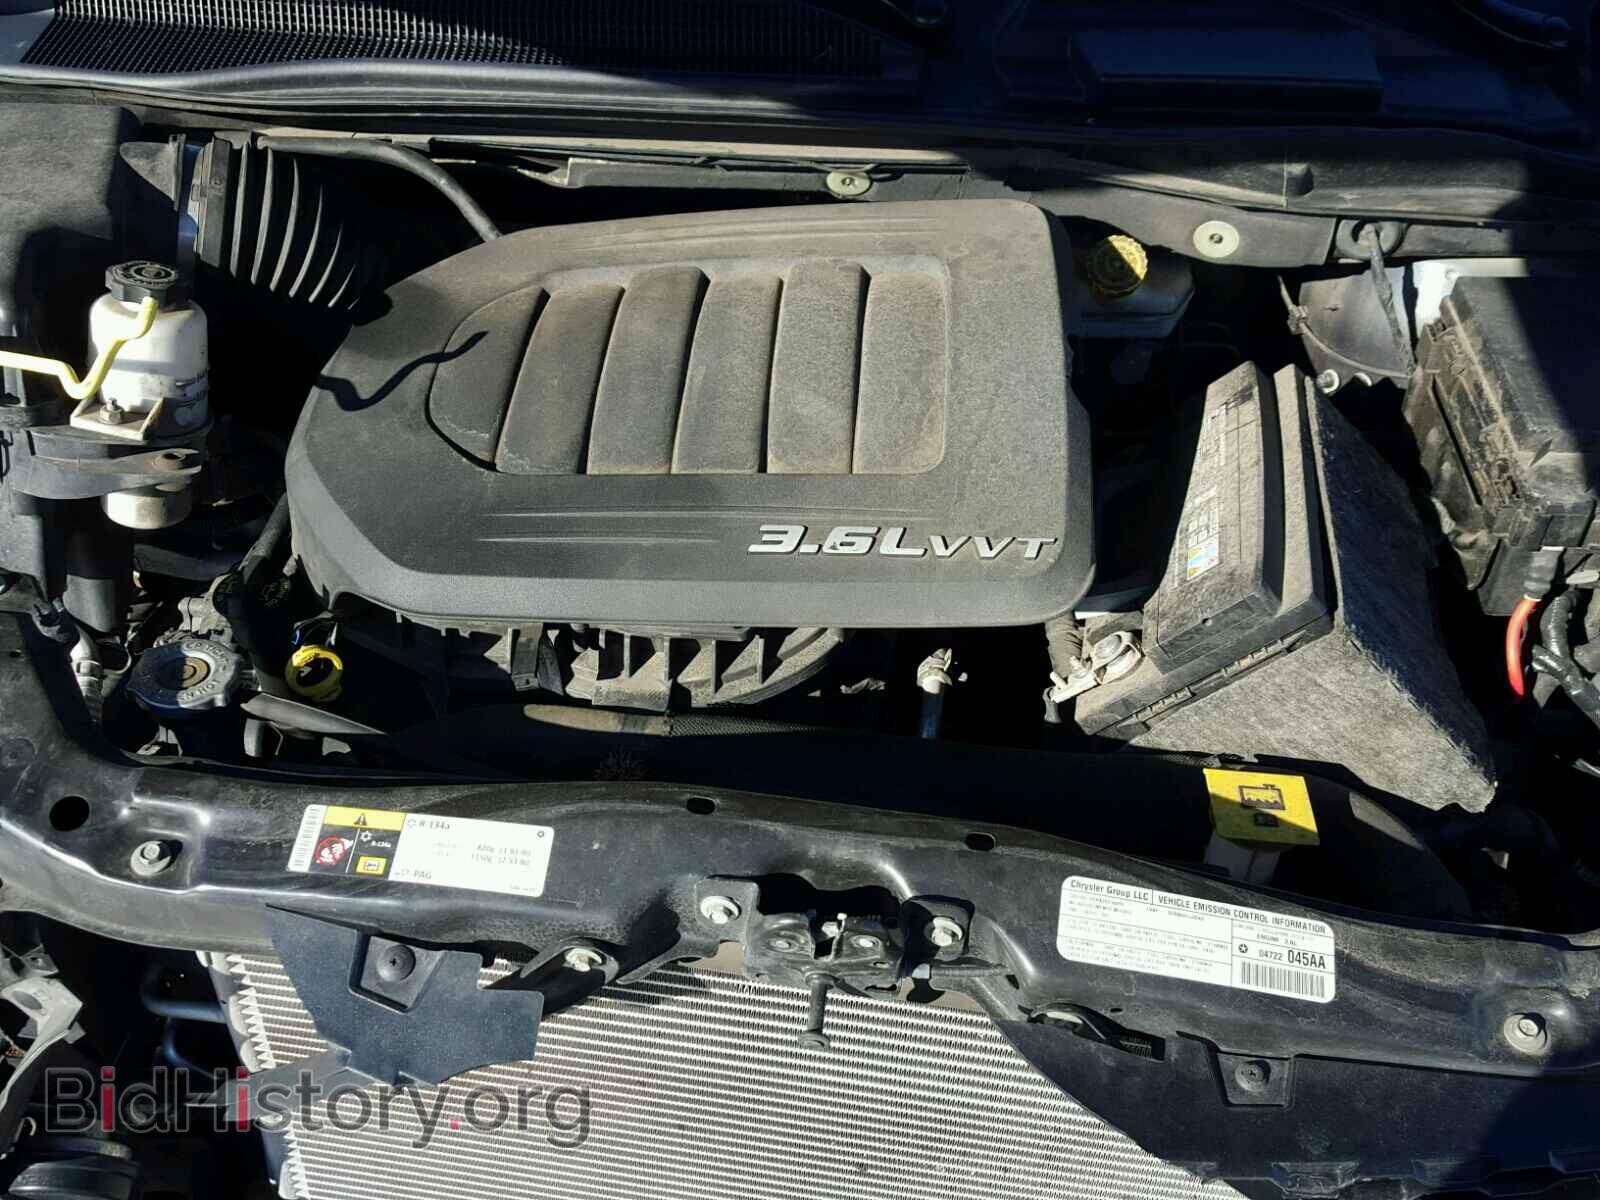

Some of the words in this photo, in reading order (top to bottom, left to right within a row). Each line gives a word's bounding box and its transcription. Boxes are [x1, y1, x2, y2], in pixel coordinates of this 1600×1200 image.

[748, 525, 927, 557] 3.6L
[929, 535, 1057, 560] VVT
[1070, 879, 1104, 894] Chrysler
[1106, 884, 1131, 899] Group
[1133, 889, 1149, 901] LLC
[1158, 895, 1191, 909] VEHICLE
[1193, 901, 1231, 916] EMISSION
[1233, 907, 1269, 924] CONTROL
[1272, 916, 1326, 934] INFORMATION
[1258, 949, 1283, 961] 04722
[1287, 949, 1326, 969] 045AA
